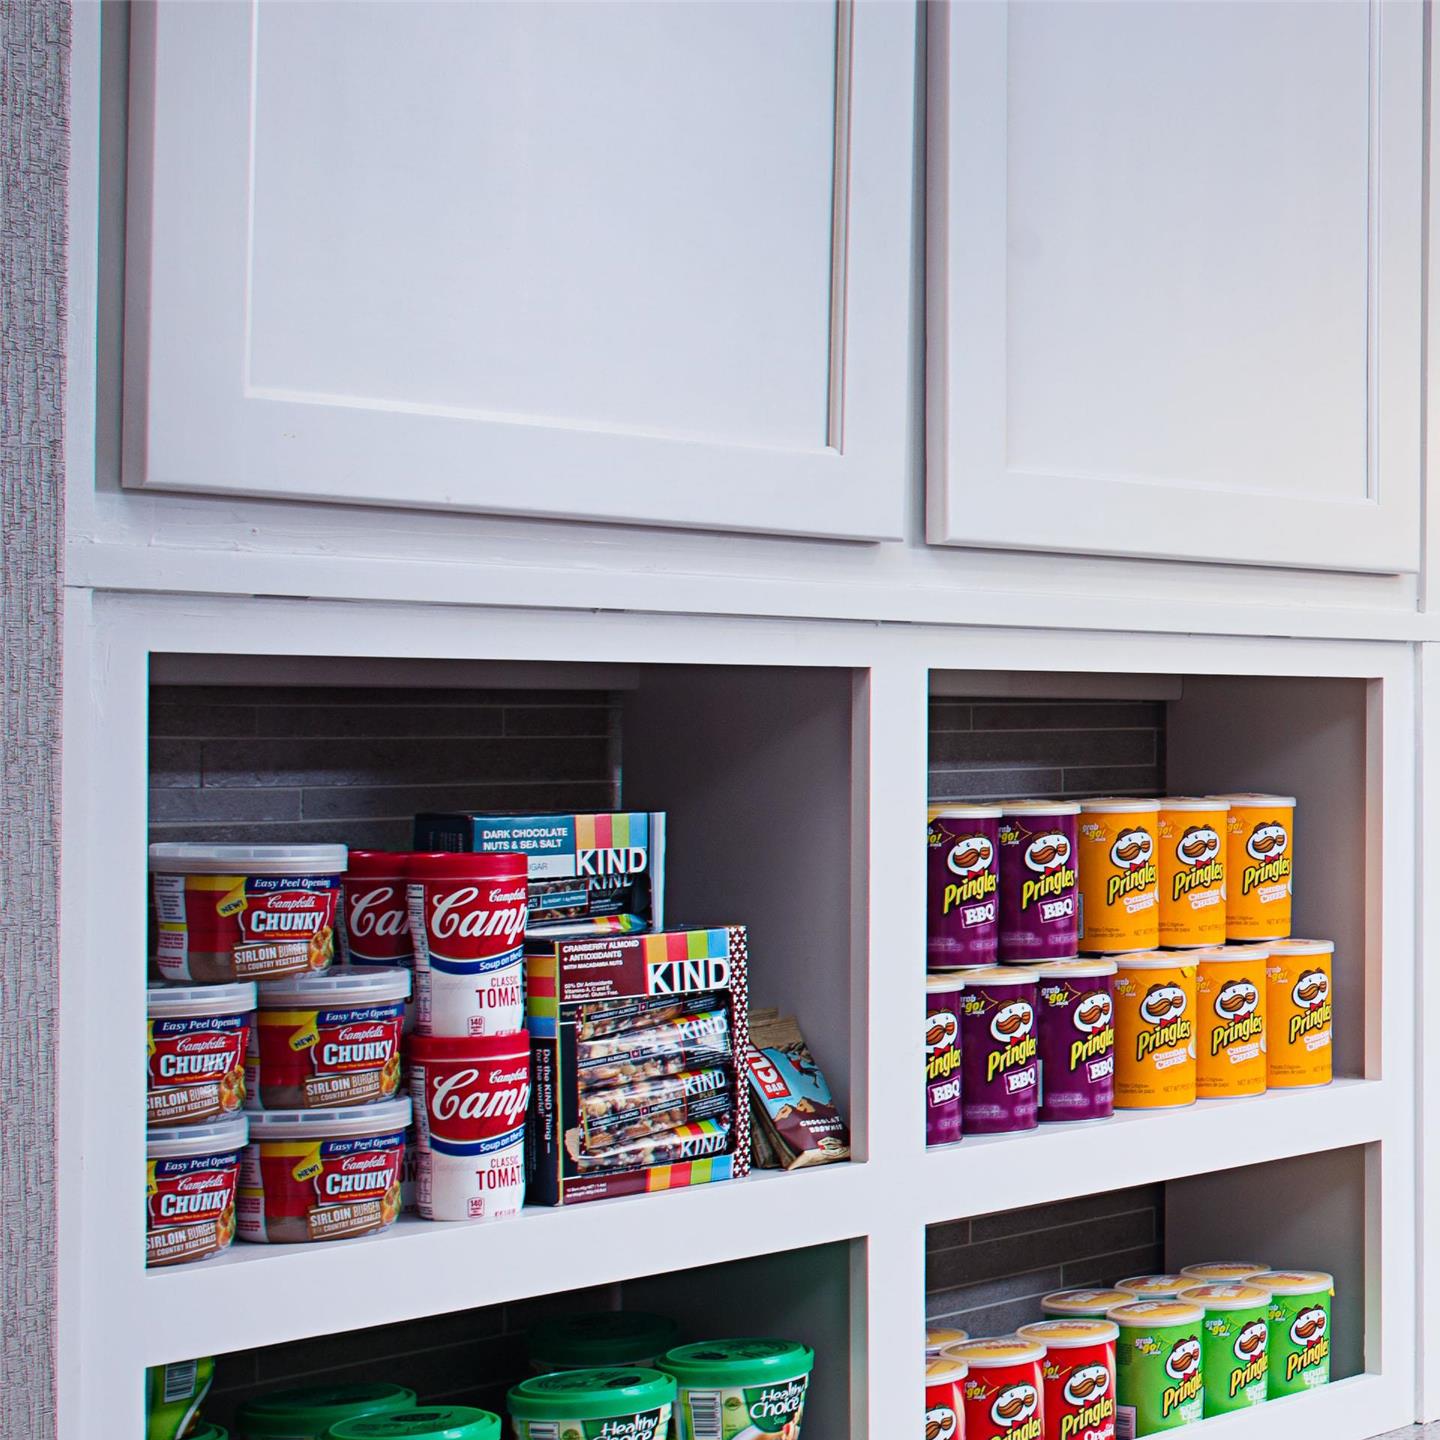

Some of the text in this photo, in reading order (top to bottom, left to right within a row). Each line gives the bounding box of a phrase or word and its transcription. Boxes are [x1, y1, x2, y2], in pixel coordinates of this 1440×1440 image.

[483, 828, 568, 839] DARK CHOCOLATE
[483, 839, 561, 851] NUTS & SEA SALT
[577, 849, 647, 876] KIND
[254, 879, 330, 889] Easy Peel Opening
[1107, 864, 1156, 905] Pringles
[1173, 860, 1223, 902] Pringles
[1242, 855, 1291, 895] Pringles
[943, 870, 996, 914] Pringles
[1022, 866, 1075, 910] Pringles
[221, 899, 245, 914] NEW!
[965, 904, 995, 925] BBQ
[1043, 898, 1073, 920] BBQ
[251, 911, 324, 933] CHUNKY
[235, 943, 307, 964] SIRLOIN BURGER
[563, 940, 639, 953] CRANBERRY ALMOND
[649, 957, 730, 995] KIND
[475, 986, 521, 1008] TOMAT
[163, 1018, 240, 1032] Easy Peel Opening
[325, 1008, 397, 1022] Easy Peel Opening
[677, 1015, 727, 1040] KIND
[1211, 1013, 1262, 1055] Pringles
[1136, 1018, 1191, 1062] Pringles
[160, 1052, 236, 1077] CHUNKY
[323, 1040, 392, 1065] CHUNKY
[926, 1047, 961, 1082] ringles
[987, 1034, 1037, 1083] Pringles
[306, 1072, 379, 1096] SIRLOIN BURGER
[684, 1070, 725, 1096] KIND
[765, 1082, 785, 1093] BAR
[1008, 1071, 1035, 1091] BBQ
[932, 1084, 960, 1103] BBQ
[679, 1136, 726, 1158] KIND
[326, 1169, 394, 1195] CHUNKY
[476, 1165, 525, 1190] TOMAT
[161, 1189, 230, 1216] CHUNKY
[310, 1203, 380, 1227] SIRLOIN BURGER
[1285, 1336, 1329, 1381] Pringles
[1230, 1349, 1268, 1397] Pringle
[759, 1382, 806, 1403] Healthy
[749, 1396, 800, 1419] Choice
[601, 1413, 659, 1436] Healthy
